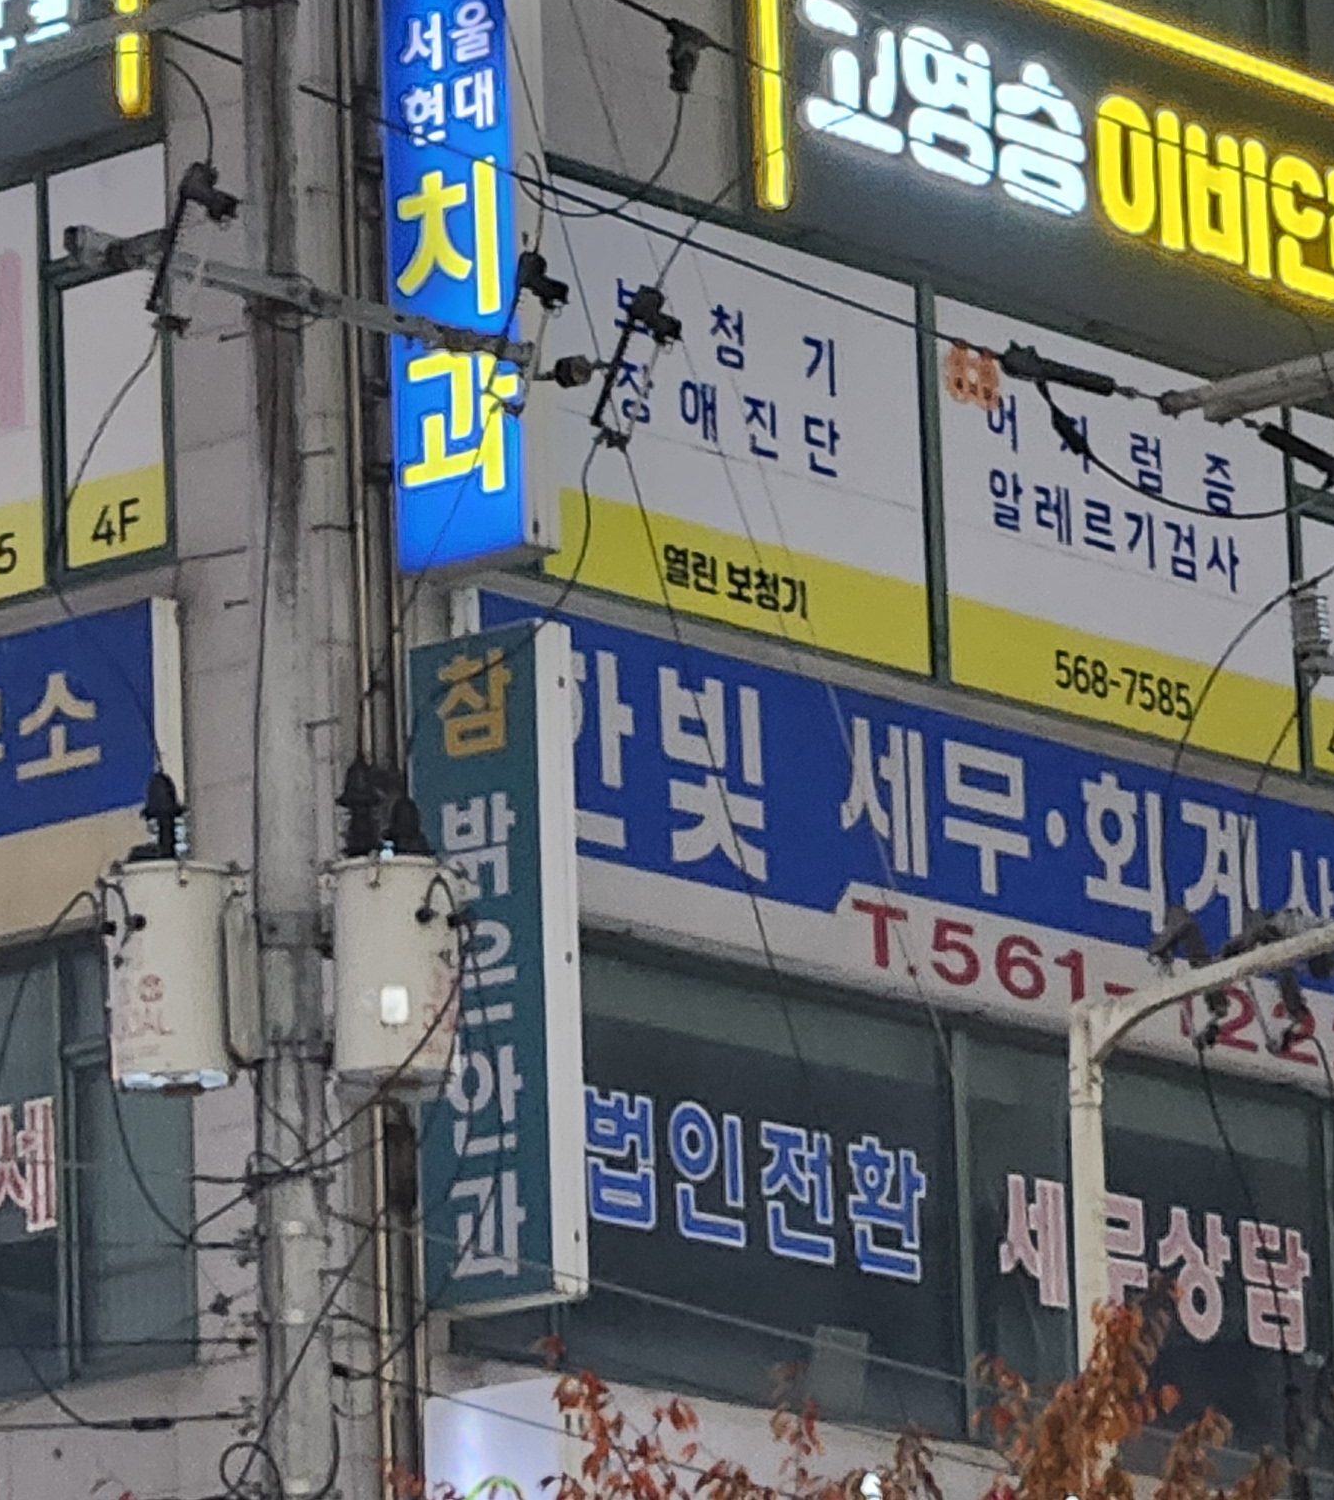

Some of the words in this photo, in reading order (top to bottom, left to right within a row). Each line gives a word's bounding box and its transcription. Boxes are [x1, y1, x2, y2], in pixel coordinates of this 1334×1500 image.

[400, 68, 496, 146] 현대
[395, 154, 520, 496] 치과
[90, 498, 141, 548] 4F
[989, 466, 1241, 596] 알레르기검사
[662, 544, 719, 594] 열린
[725, 560, 809, 620] 보청기
[1054, 648, 1195, 724] 568-7585
[583, 1084, 929, 1286] 법인전환
